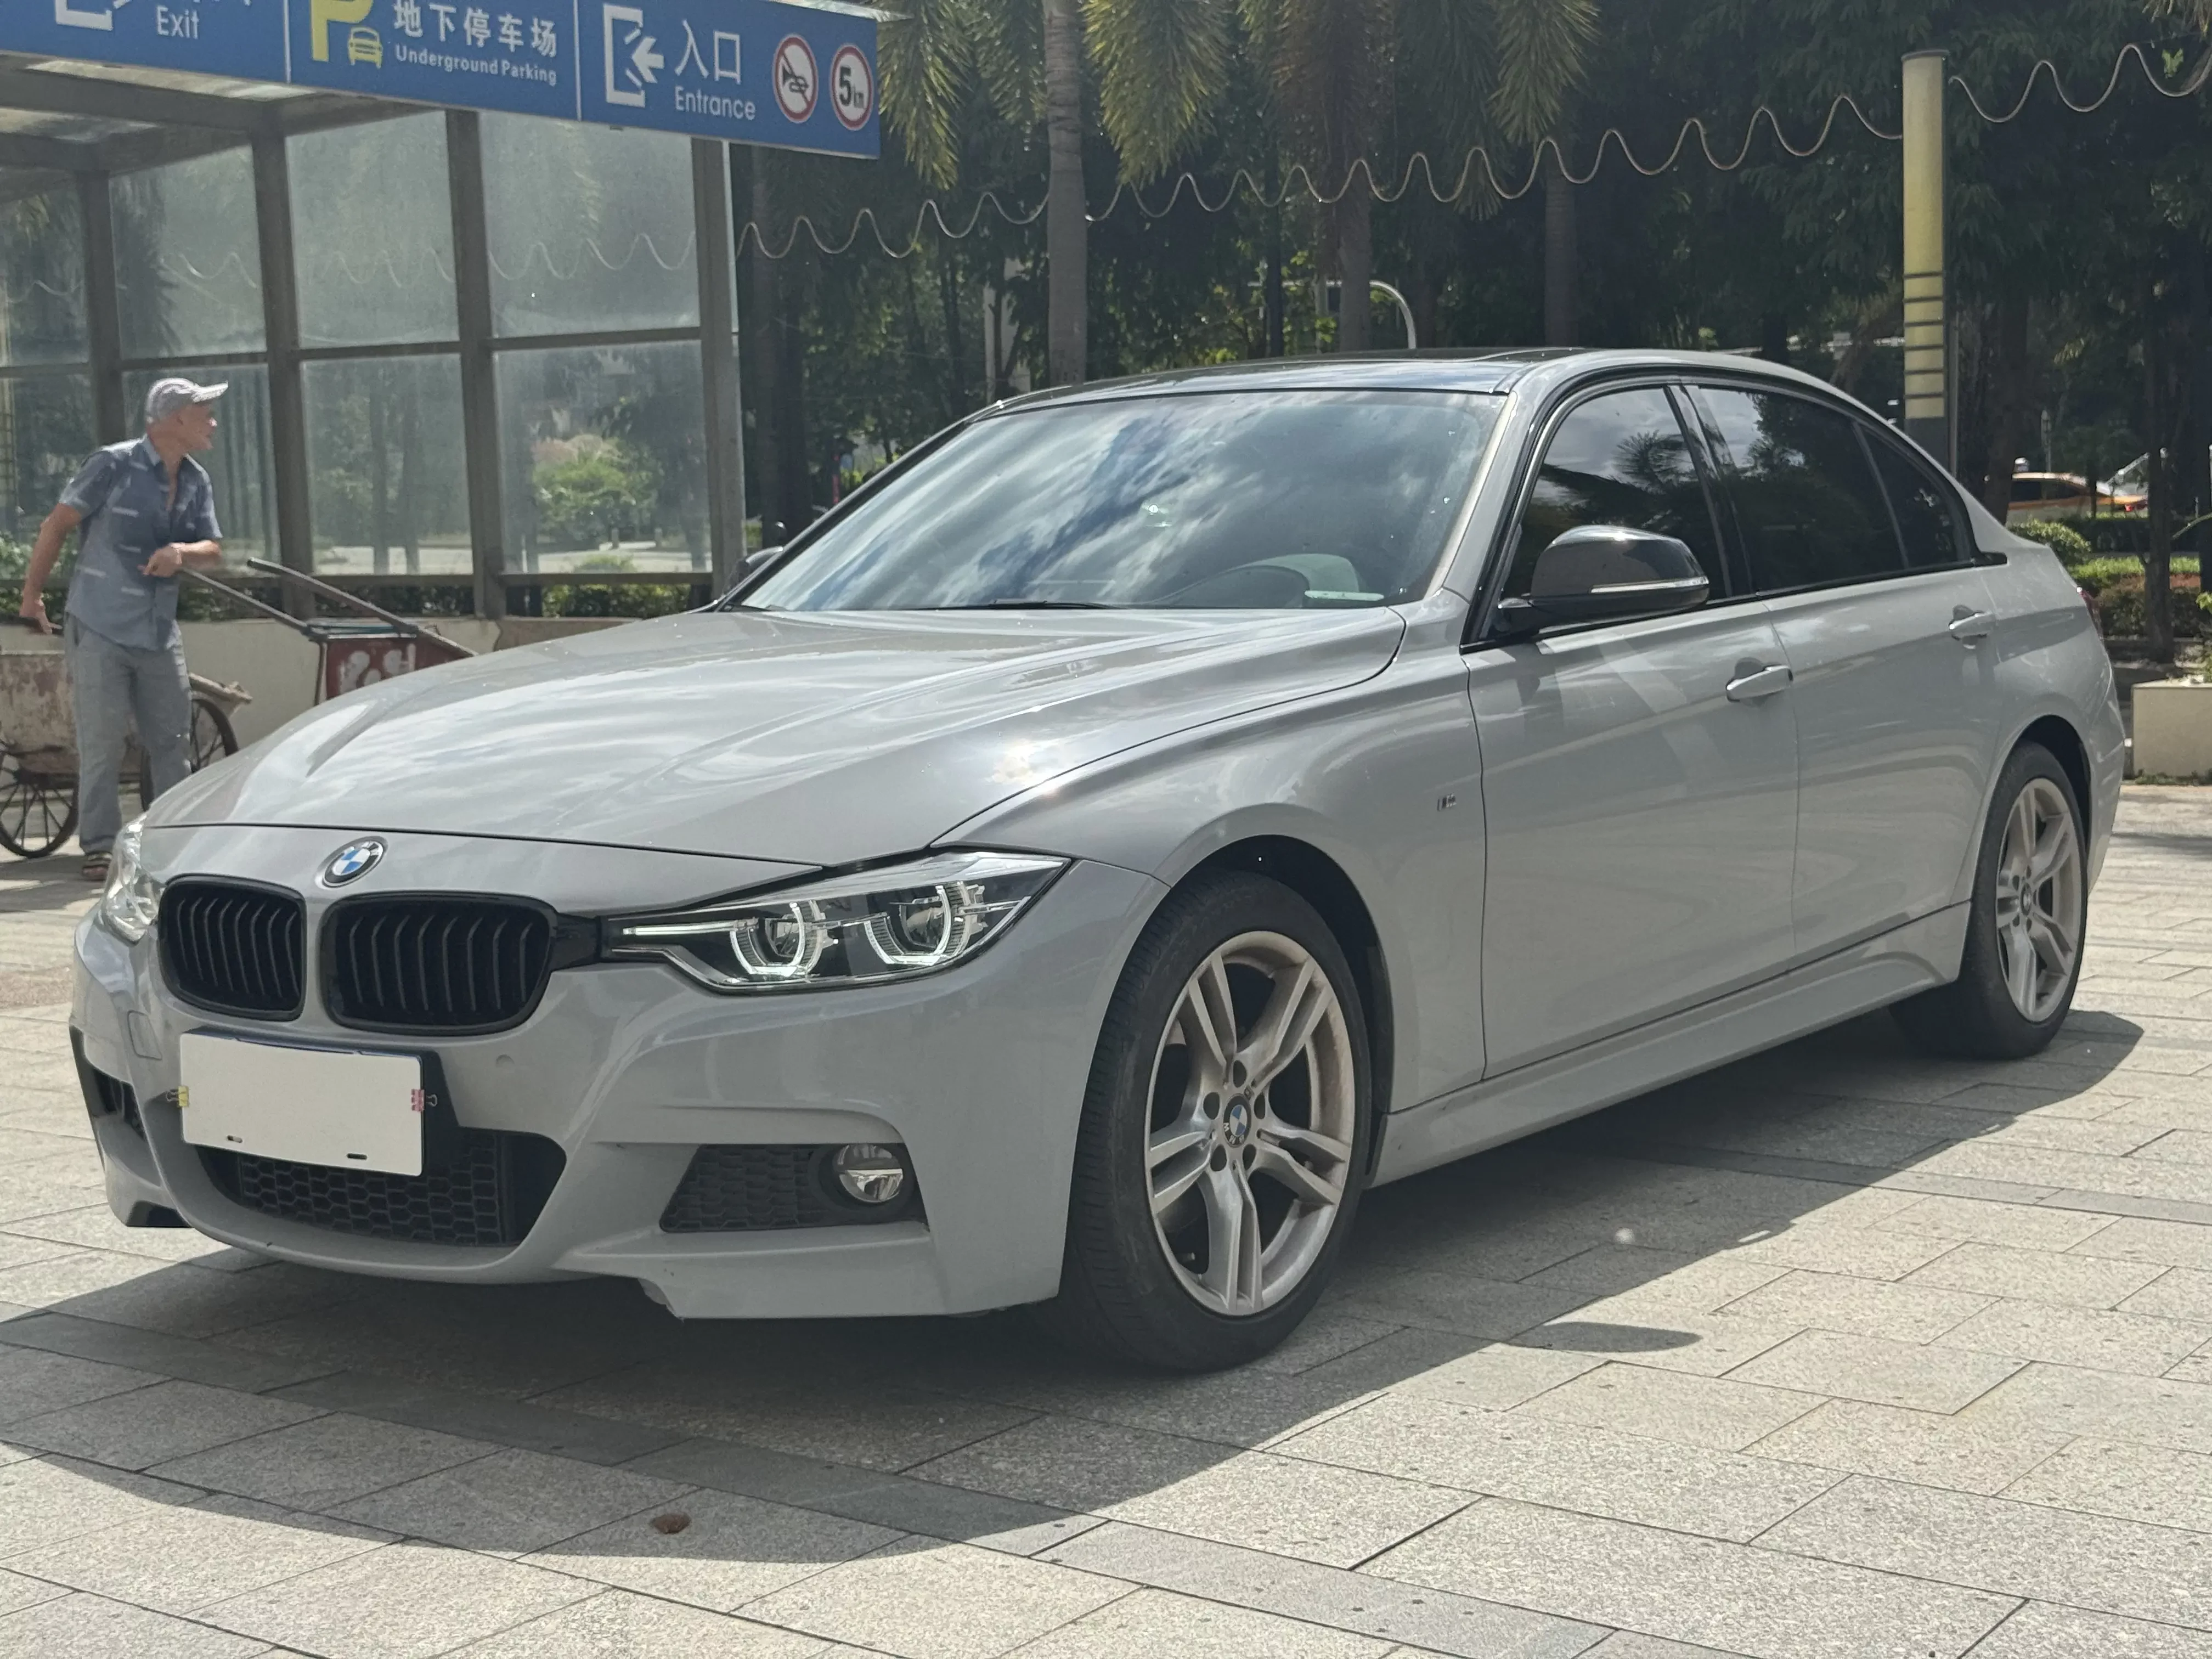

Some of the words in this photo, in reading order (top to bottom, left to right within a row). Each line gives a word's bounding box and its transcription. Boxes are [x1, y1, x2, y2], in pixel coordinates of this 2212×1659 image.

[157, 5, 199, 39] Exit
[311, 0, 373, 61] P
[393, 0, 557, 57] 地下停车场
[395, 43, 498, 75] Underground
[501, 59, 557, 87] Parking
[674, 19, 741, 85] 入口
[675, 85, 756, 121] Entrance
